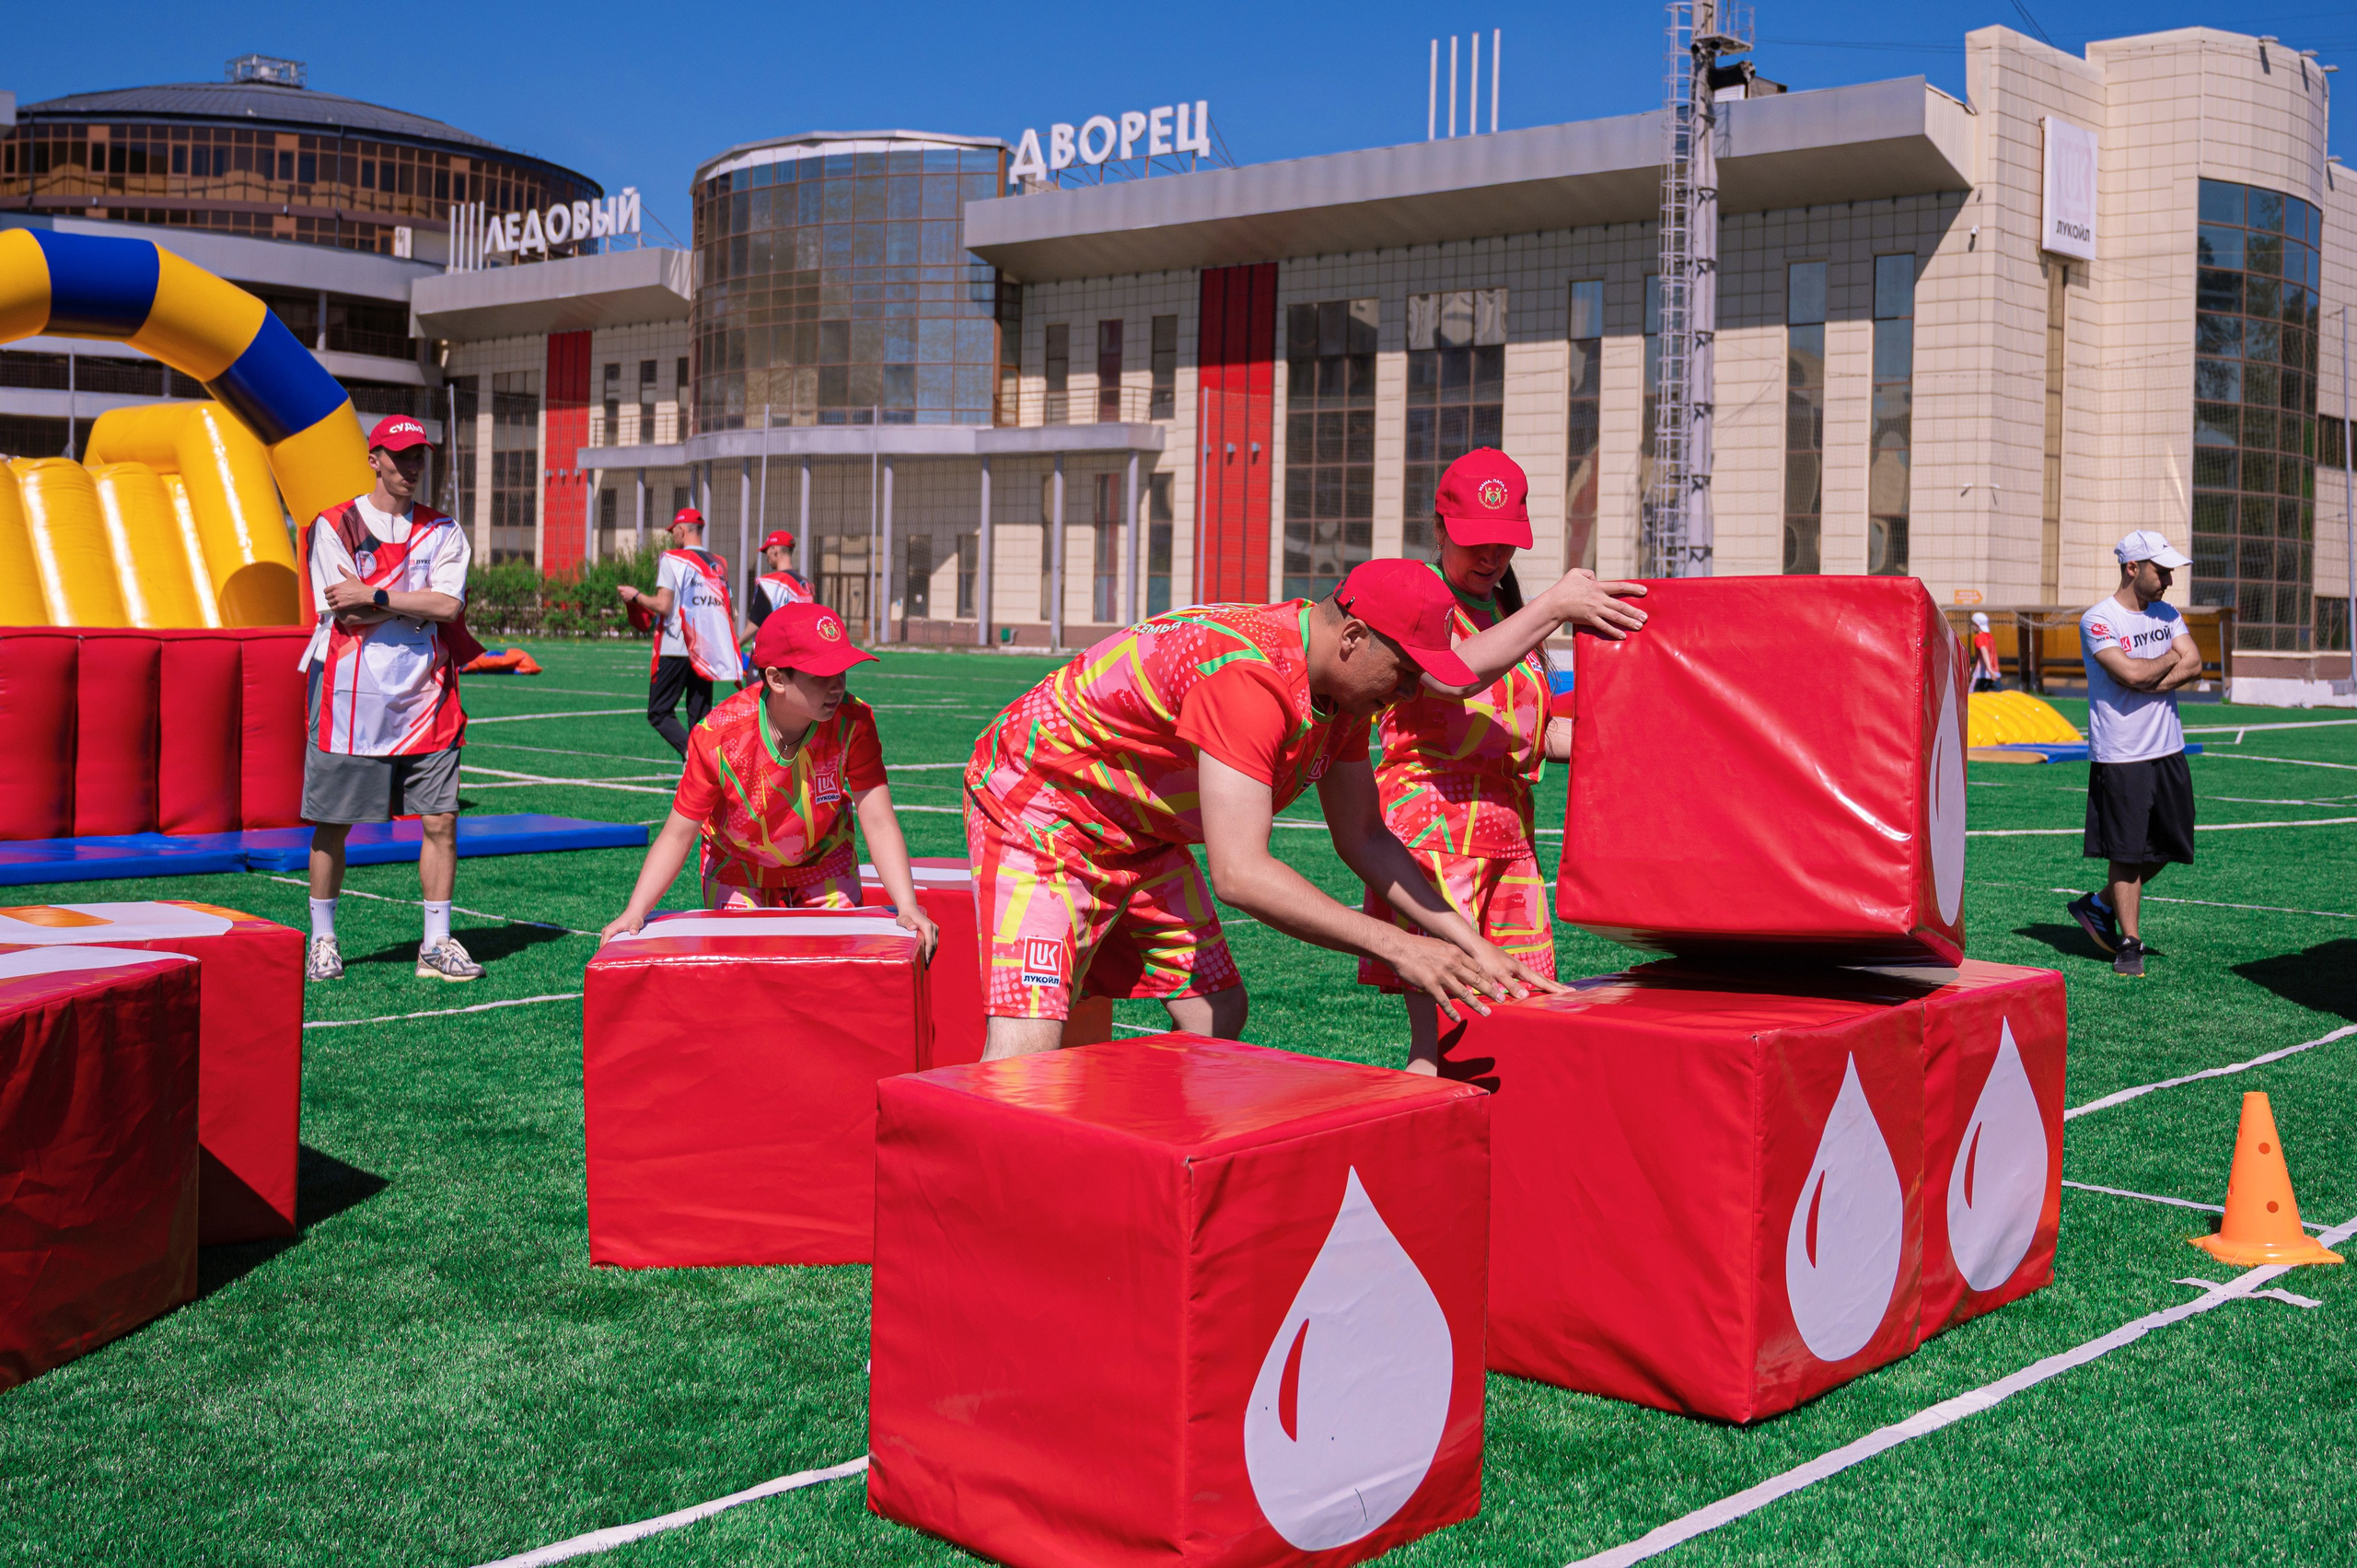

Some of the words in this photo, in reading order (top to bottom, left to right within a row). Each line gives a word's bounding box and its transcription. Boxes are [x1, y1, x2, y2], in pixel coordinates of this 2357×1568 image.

[1009, 100, 1211, 185] ДВОРЕЦ
[484, 187, 641, 256] ЛЕДОВЫЙ
[2056, 220, 2090, 242] ЛУКОЙЛ
[389, 422, 424, 434] СУДЬЯ
[1134, 621, 1183, 633] СЕМЬЯ
[2133, 625, 2173, 648] ЛУКОЙ
[817, 795, 840, 803] ЛУКОЙЛ
[1029, 942, 1058, 971] LUK
[1023, 975, 1060, 985] ЛУКОЙЛ
